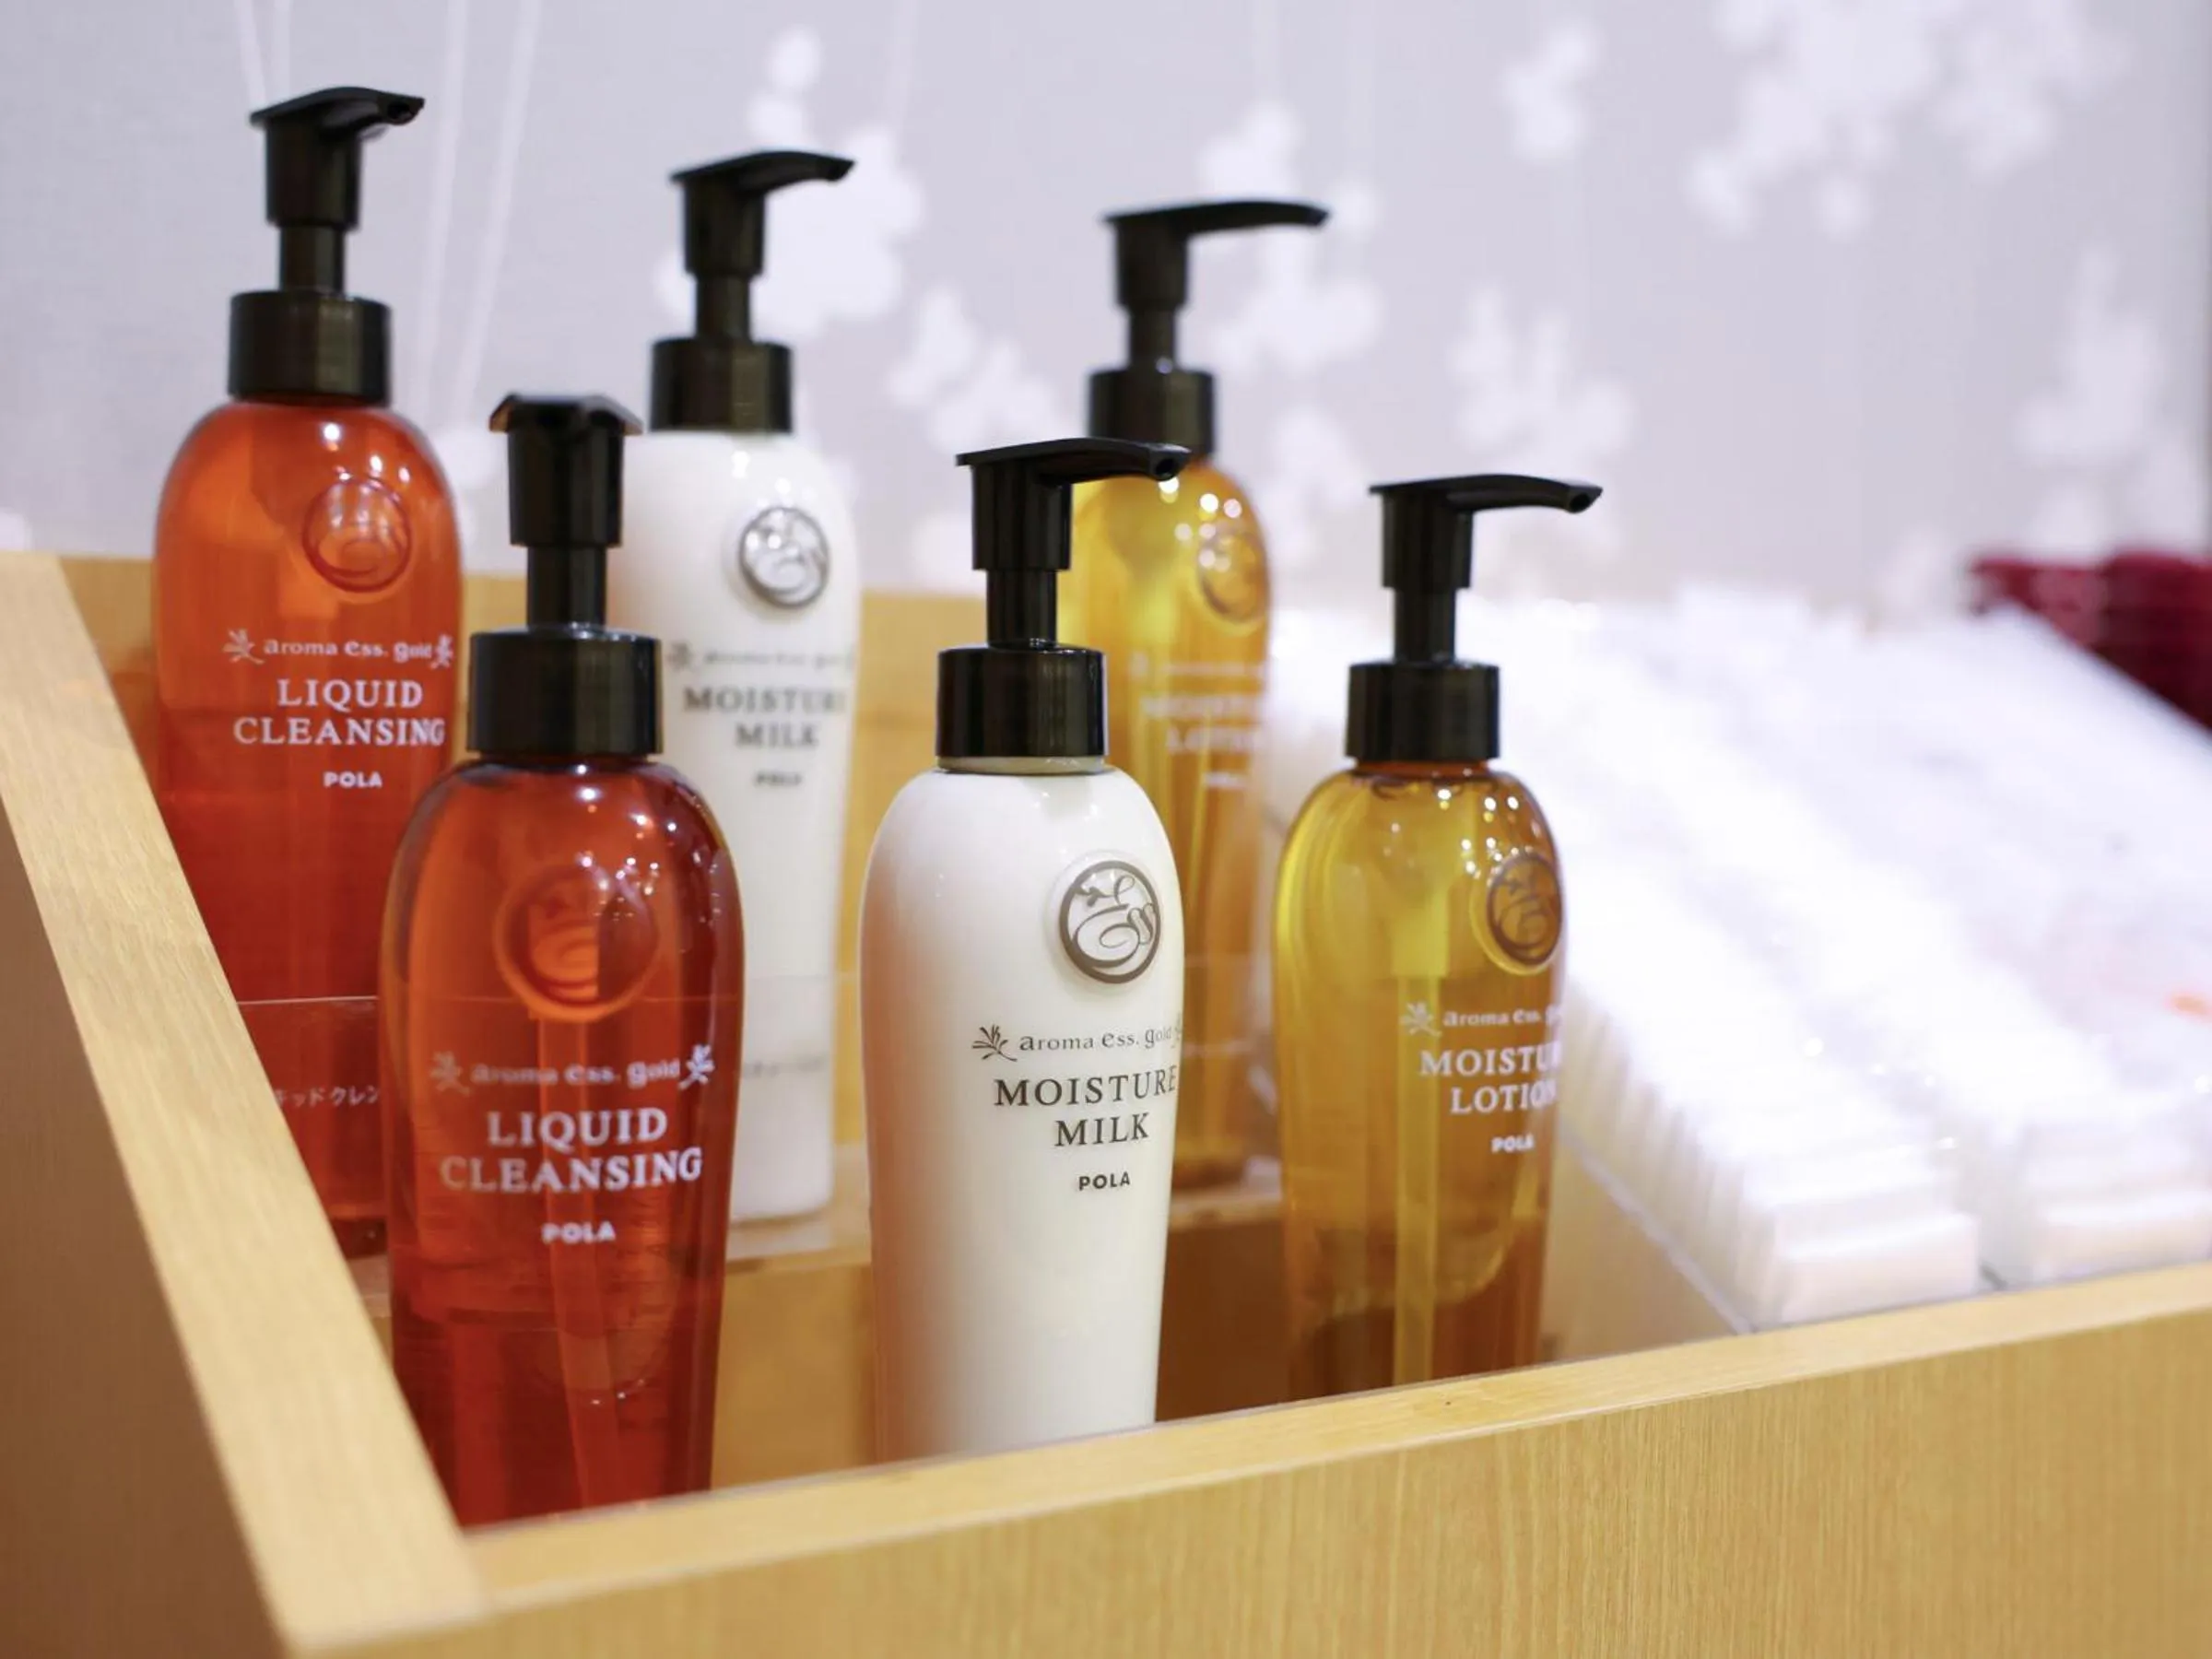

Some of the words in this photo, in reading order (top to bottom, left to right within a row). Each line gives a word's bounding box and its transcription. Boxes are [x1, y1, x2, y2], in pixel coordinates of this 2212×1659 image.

[277, 679, 424, 712] LIQUID
[233, 717, 445, 747] CLEANSING
[736, 723, 818, 747] MILK
[324, 771, 382, 788] POLA
[1019, 1035, 1094, 1052] aroma
[1101, 1032, 1140, 1049] ess.
[994, 1065, 1178, 1107] MOISTURE
[487, 1107, 668, 1154] LIQUID
[1054, 1112, 1149, 1147] MILK
[439, 1147, 702, 1193] CLEANSING
[1078, 1171, 1131, 1191] POLA
[541, 1221, 616, 1244] POLA
